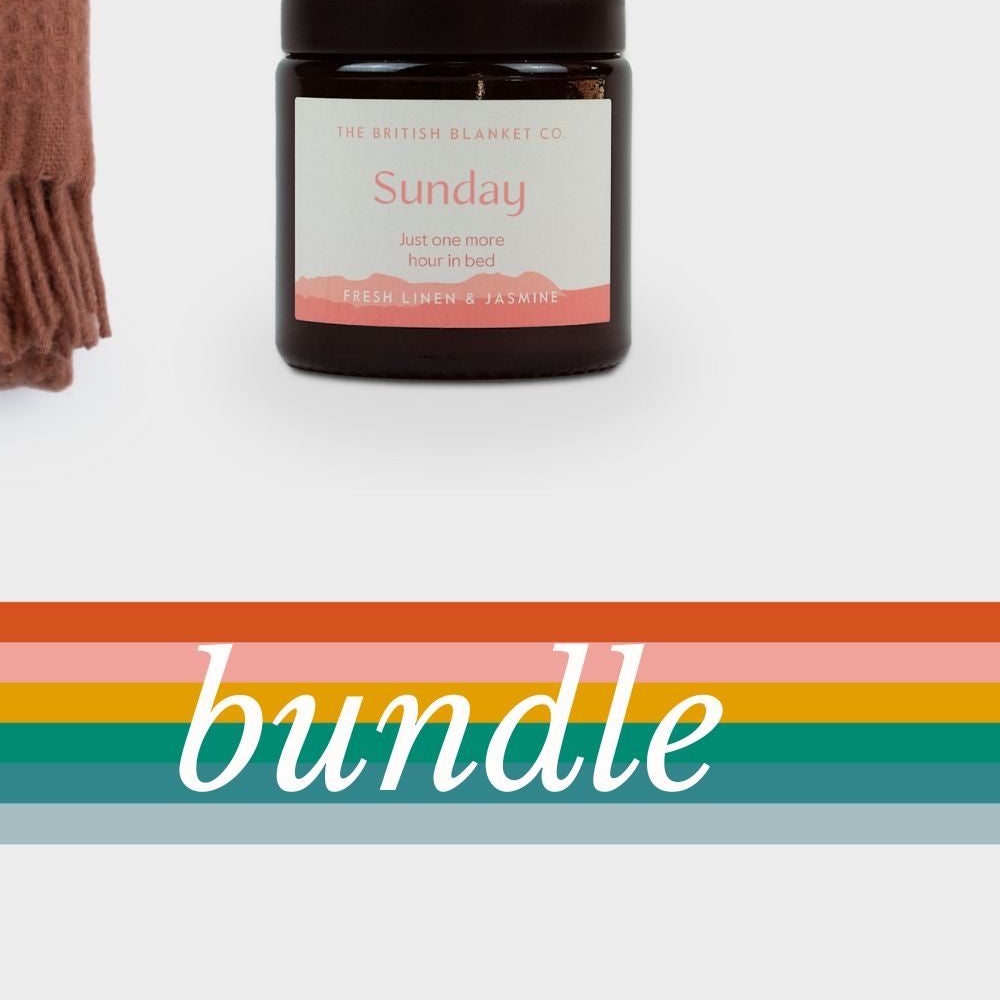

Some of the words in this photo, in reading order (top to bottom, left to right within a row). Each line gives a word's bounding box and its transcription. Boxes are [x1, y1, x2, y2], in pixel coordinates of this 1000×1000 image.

[337, 126, 364, 138] THE
[372, 127, 441, 140] BRITISH
[450, 128, 532, 140] BLANKET
[539, 127, 566, 140] CO.
[374, 169, 526, 217] Sunday
[399, 232, 428, 247] Just
[431, 236, 461, 247] one
[466, 236, 505, 247] more
[408, 253, 444, 267] hour
[448, 254, 461, 267] in
[465, 253, 496, 267] bed
[343, 289, 393, 303] FRESH
[402, 292, 456, 304] LINEN
[465, 292, 476, 305] &
[485, 291, 558, 305] JASMINE
